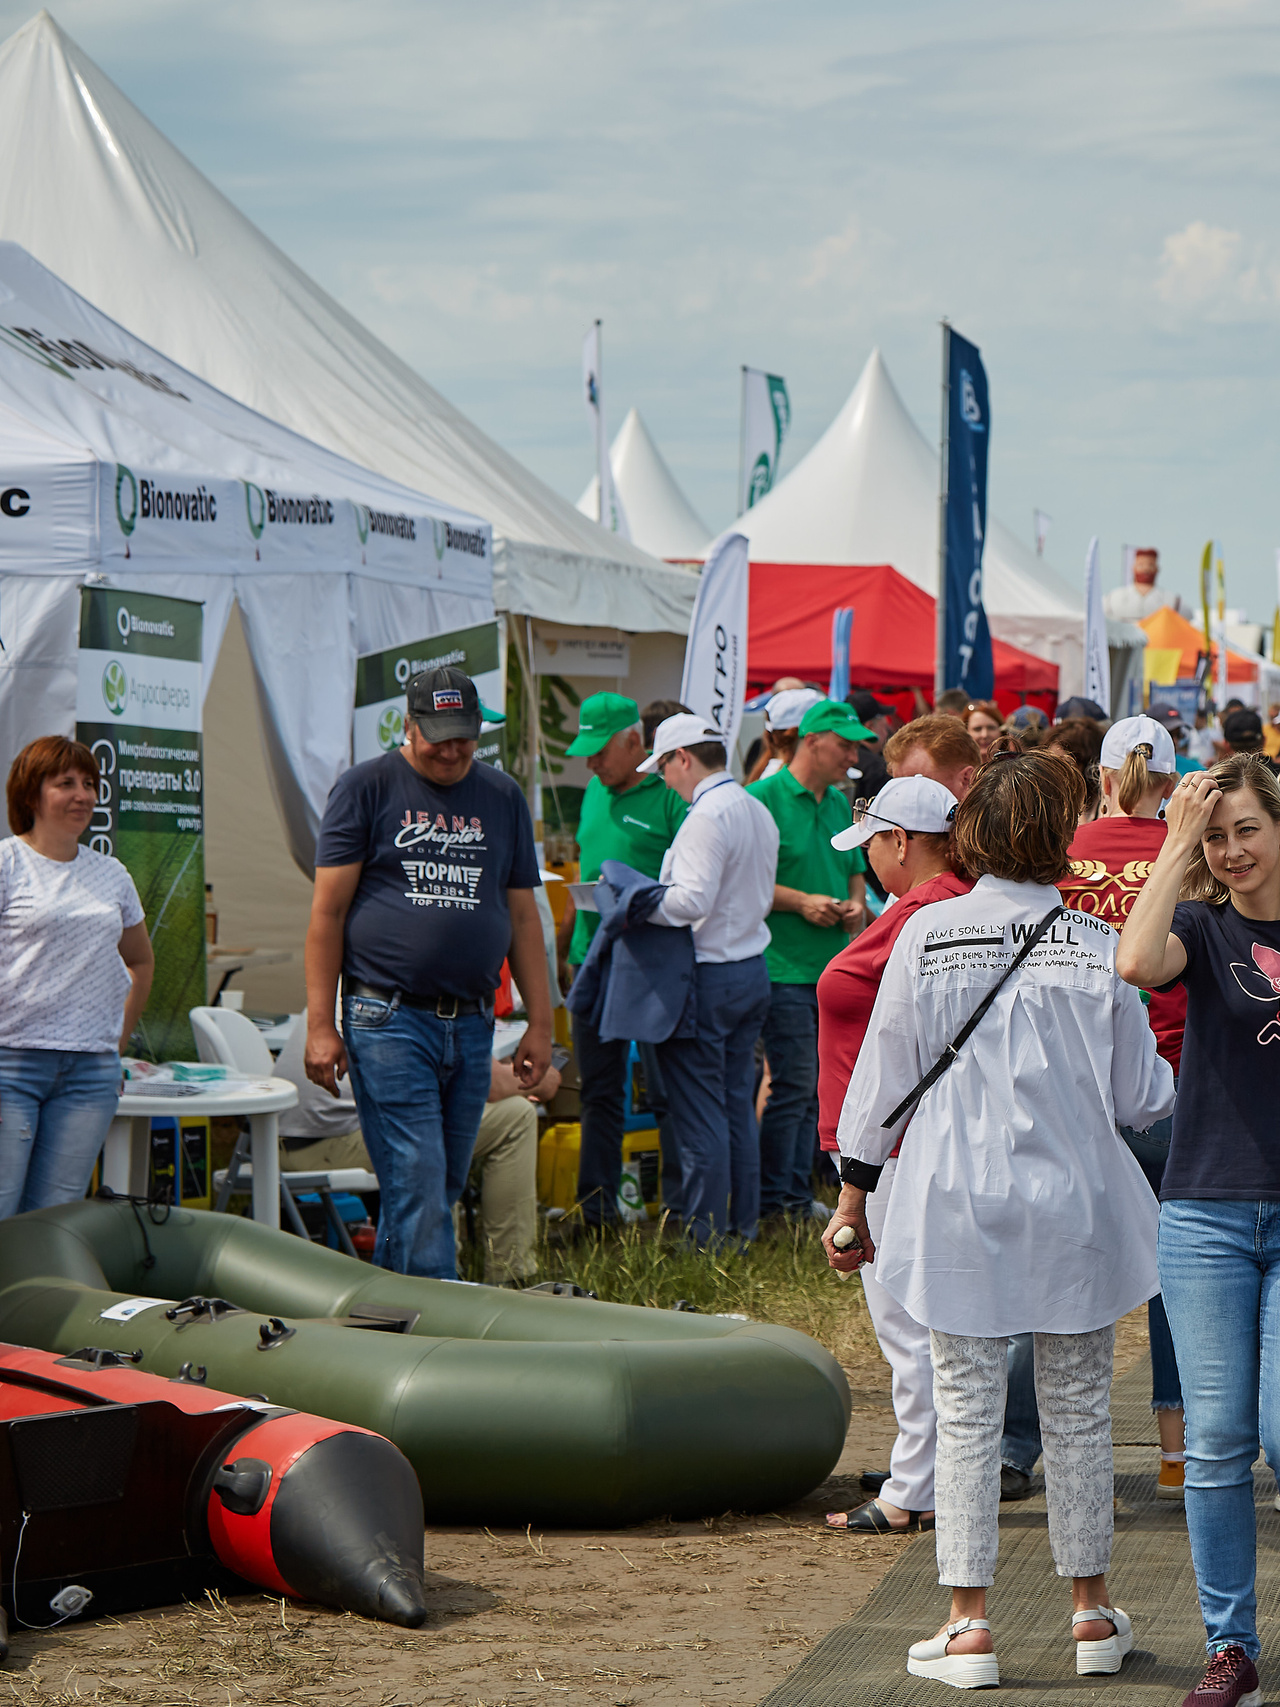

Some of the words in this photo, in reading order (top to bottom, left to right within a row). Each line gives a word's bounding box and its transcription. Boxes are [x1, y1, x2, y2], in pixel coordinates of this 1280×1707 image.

[139, 479, 218, 523] Bionovatic
[265, 489, 335, 525] Bionovatic
[131, 614, 175, 637] Bionovatic
[130, 677, 190, 711] Агросфера
[118, 739, 200, 762] Микробиологические
[119, 769, 182, 794] препараты
[401, 809, 482, 833] JEANS
[394, 821, 484, 855] Chapter
[407, 846, 476, 860] EDIZONE
[411, 898, 434, 907] TOP
[455, 901, 474, 911] TEN
[1060, 912, 1111, 936] DOING
[941, 953, 960, 963] JUST
[962, 951, 983, 960] BEING
[942, 963, 966, 972] HARD
